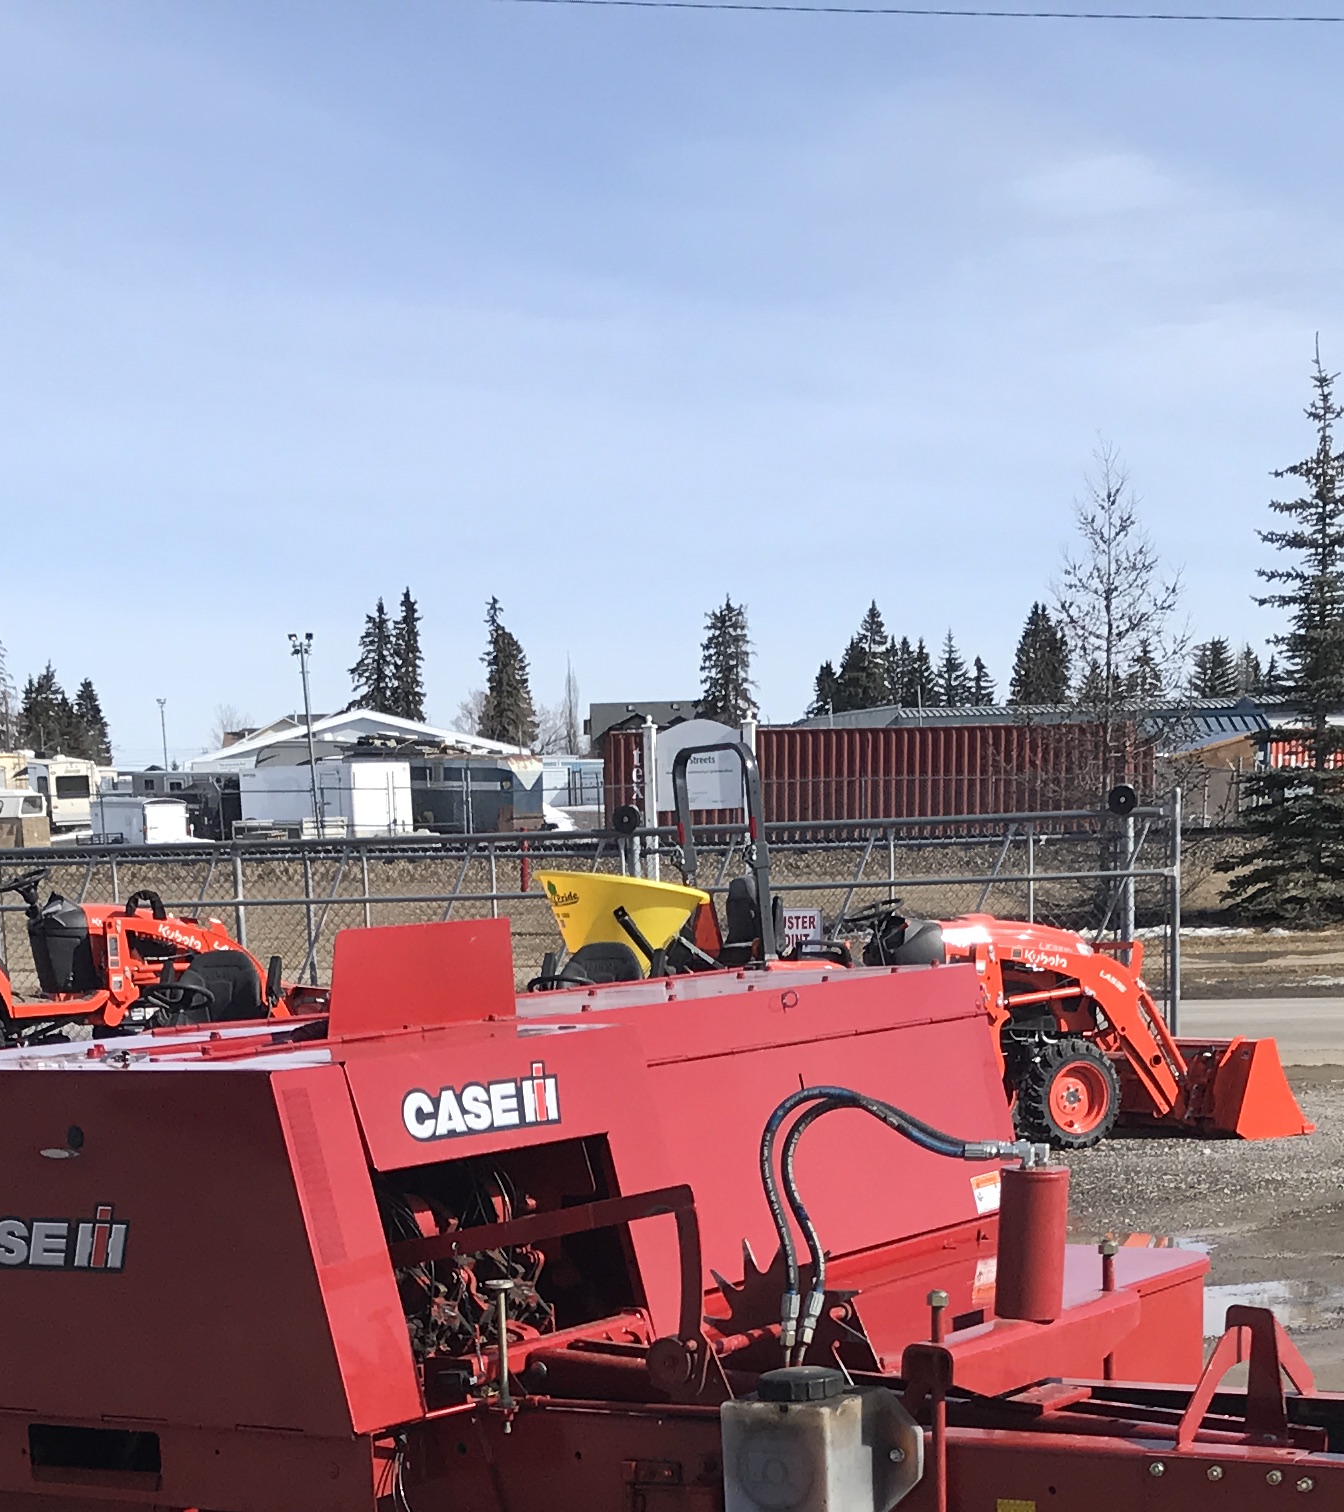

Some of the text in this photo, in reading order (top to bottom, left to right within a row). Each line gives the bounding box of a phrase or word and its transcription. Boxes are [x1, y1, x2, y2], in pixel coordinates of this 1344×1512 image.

[158, 924, 202, 950] Kubota
[1024, 949, 1067, 968] Kubota
[403, 1082, 519, 1139] CASE
